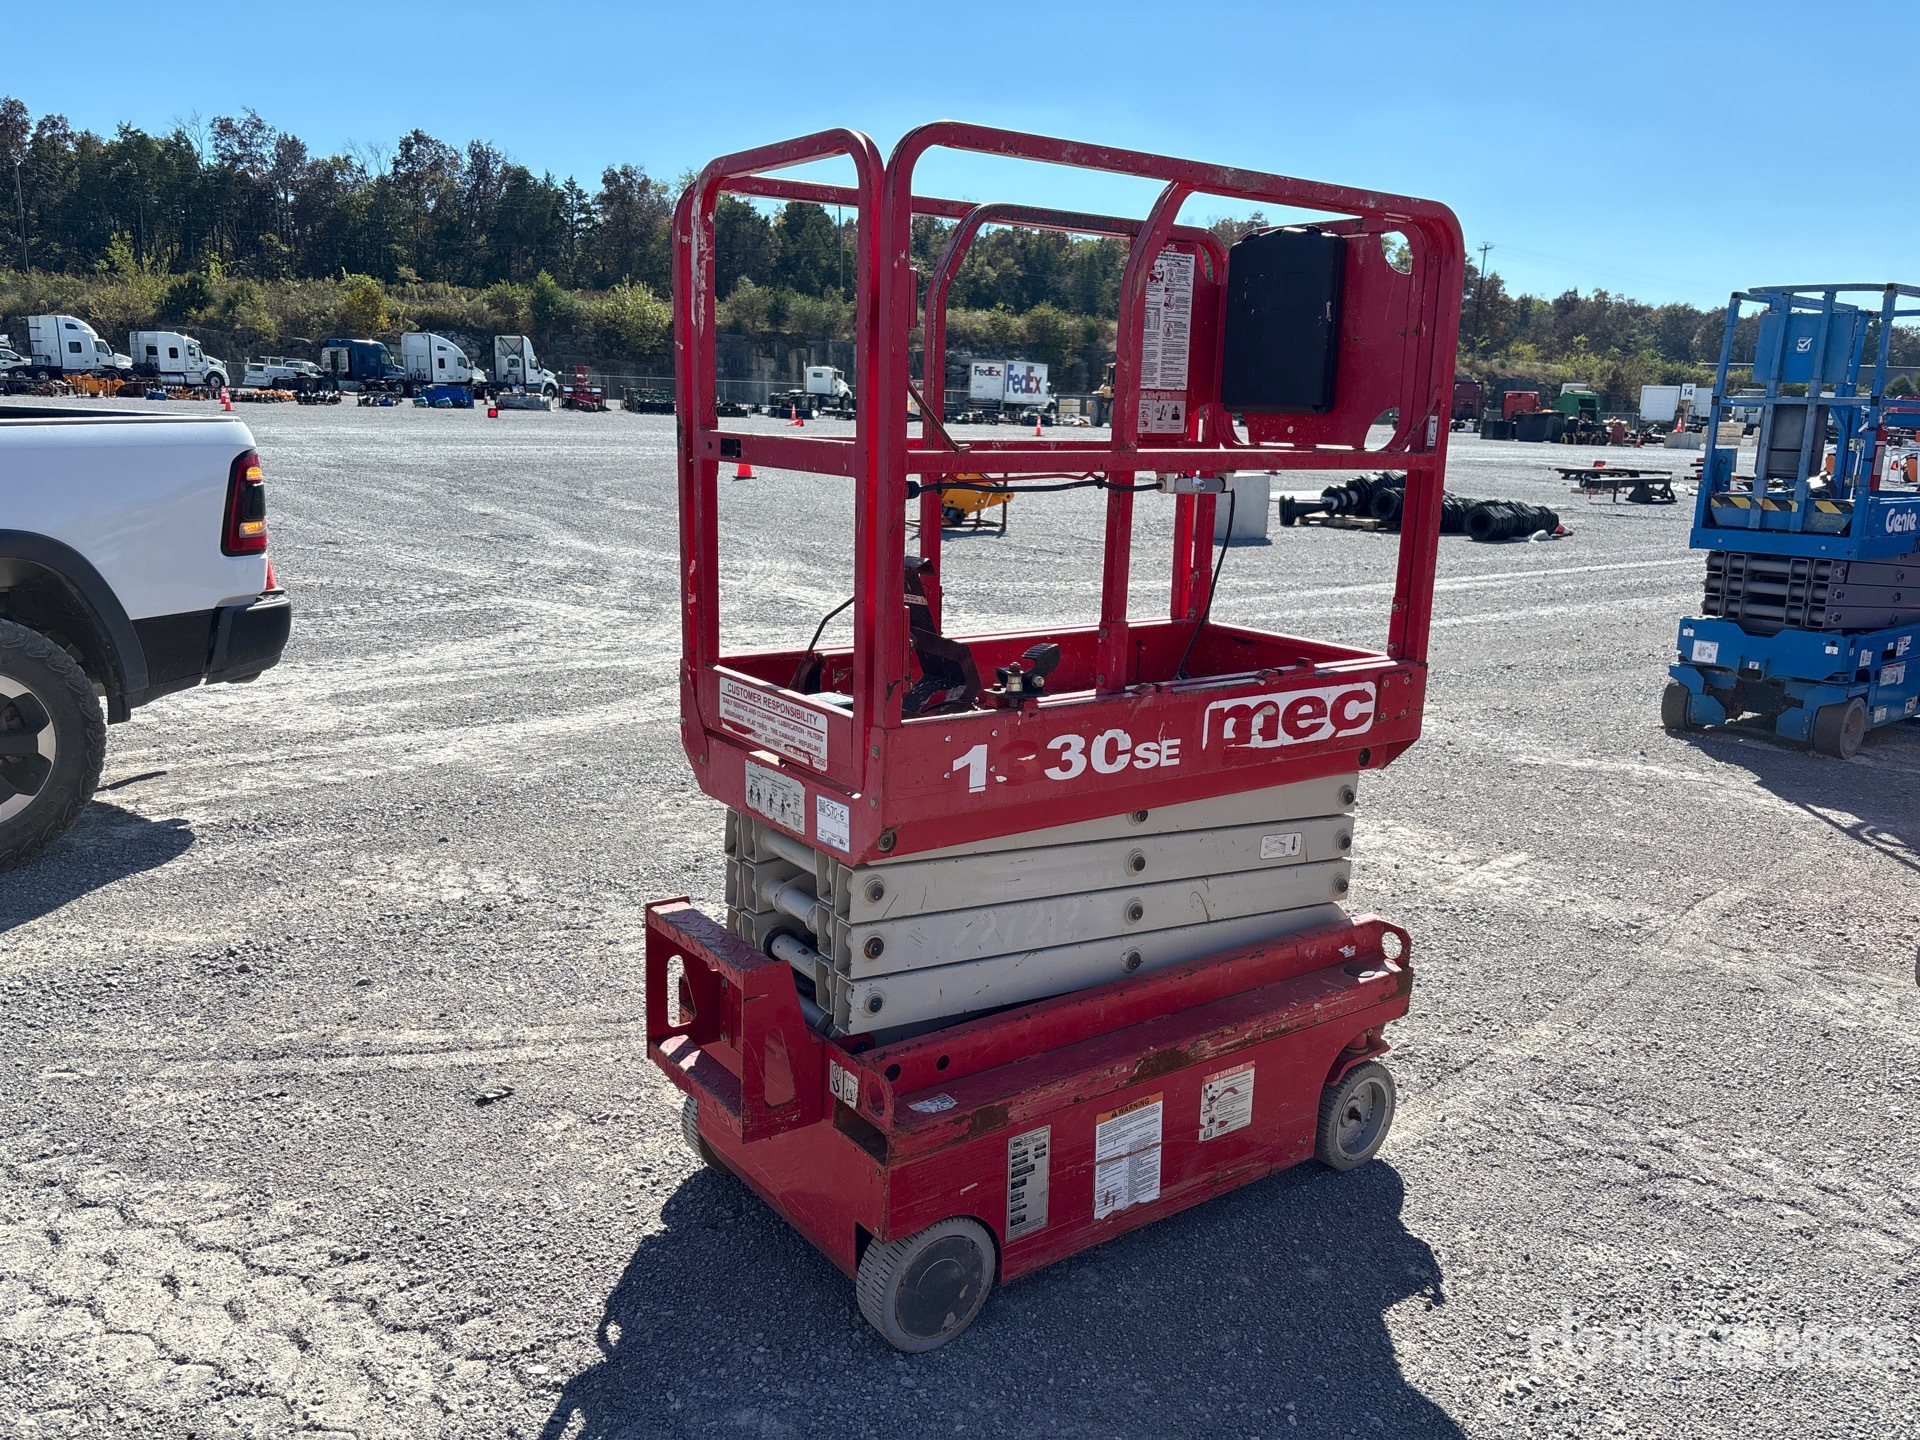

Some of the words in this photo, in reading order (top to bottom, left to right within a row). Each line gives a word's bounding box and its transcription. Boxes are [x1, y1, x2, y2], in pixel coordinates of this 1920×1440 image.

[974, 365, 1002, 377] FedEx
[1006, 364, 1042, 395] FedEx
[1683, 388, 1693, 396] 14
[1885, 507, 1917, 533] Genie
[727, 682, 762, 704] CUSTOMER
[763, 696, 818, 726] RESPONSIBILITY
[733, 700, 749, 712] SERVICE
[806, 730, 824, 743] FILTERS
[1206, 689, 1375, 746] mec
[1219, 1063, 1245, 1079] DANGER
[1118, 1097, 1151, 1116] WARNING
